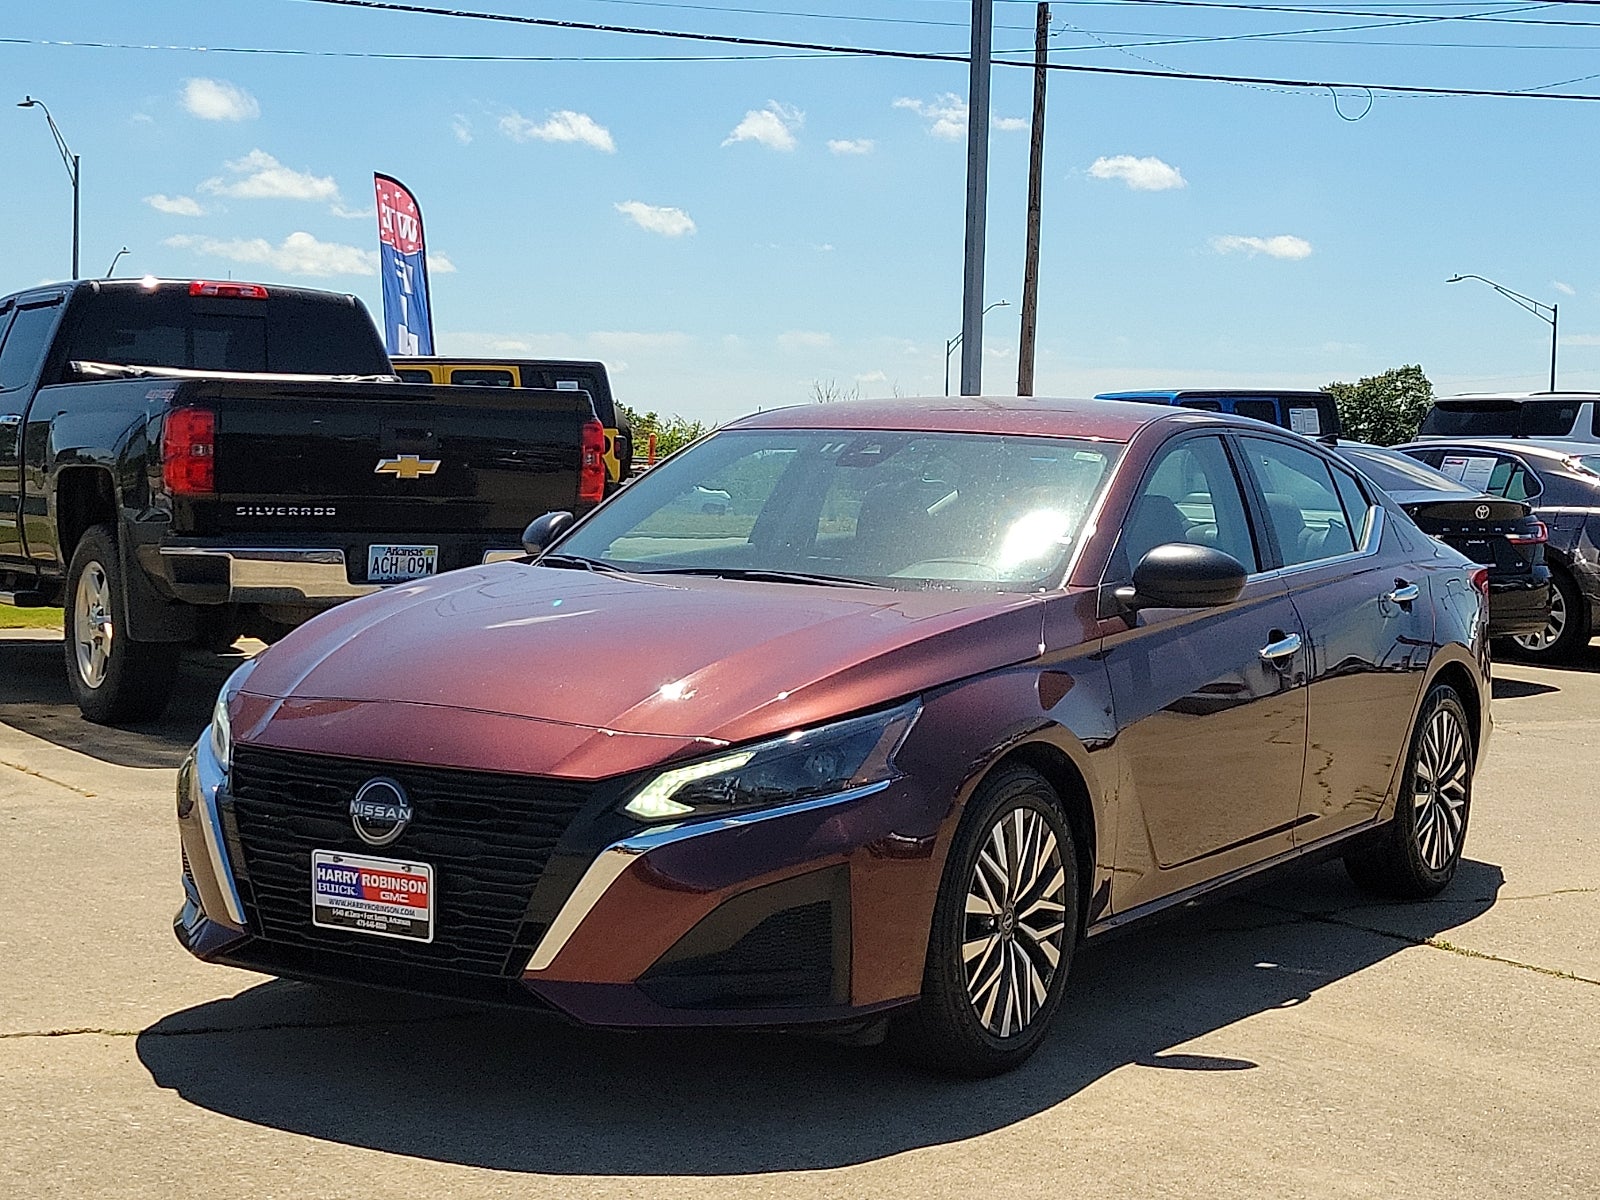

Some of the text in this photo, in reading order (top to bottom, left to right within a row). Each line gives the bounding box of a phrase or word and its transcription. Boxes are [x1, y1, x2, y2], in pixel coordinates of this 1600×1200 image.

[235, 506, 336, 516] SILVERADO
[384, 546, 425, 556] Arkansas
[371, 556, 399, 575] ACH
[349, 799, 411, 820] NISSAN
[317, 867, 427, 894] HARRY ROBINSON
[317, 882, 359, 896] BUICK
[380, 891, 410, 903] GMC
[328, 898, 416, 917] WWW.HARRYROBINSON.COM
